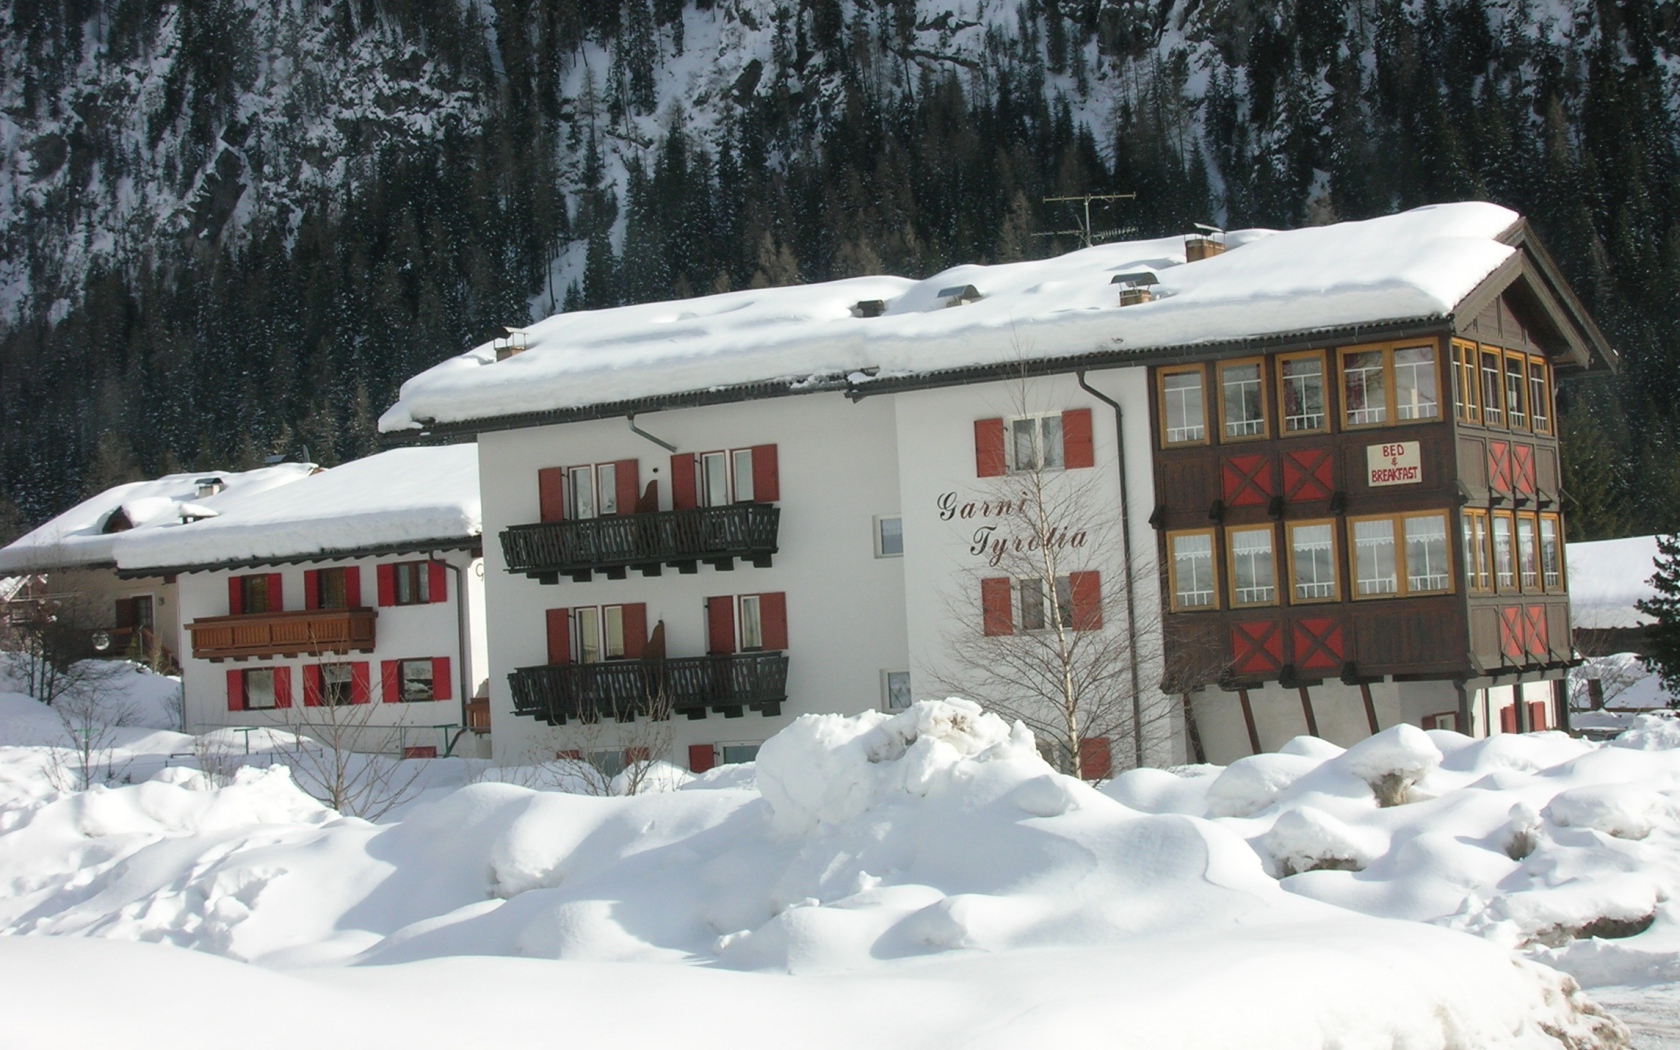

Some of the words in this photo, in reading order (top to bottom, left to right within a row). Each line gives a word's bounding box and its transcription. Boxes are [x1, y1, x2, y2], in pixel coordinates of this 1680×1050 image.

[1382, 444, 1405, 457] BED
[1391, 456, 1398, 467] &
[1371, 466, 1418, 483] BREAKFAST
[937, 491, 1028, 521] Garni
